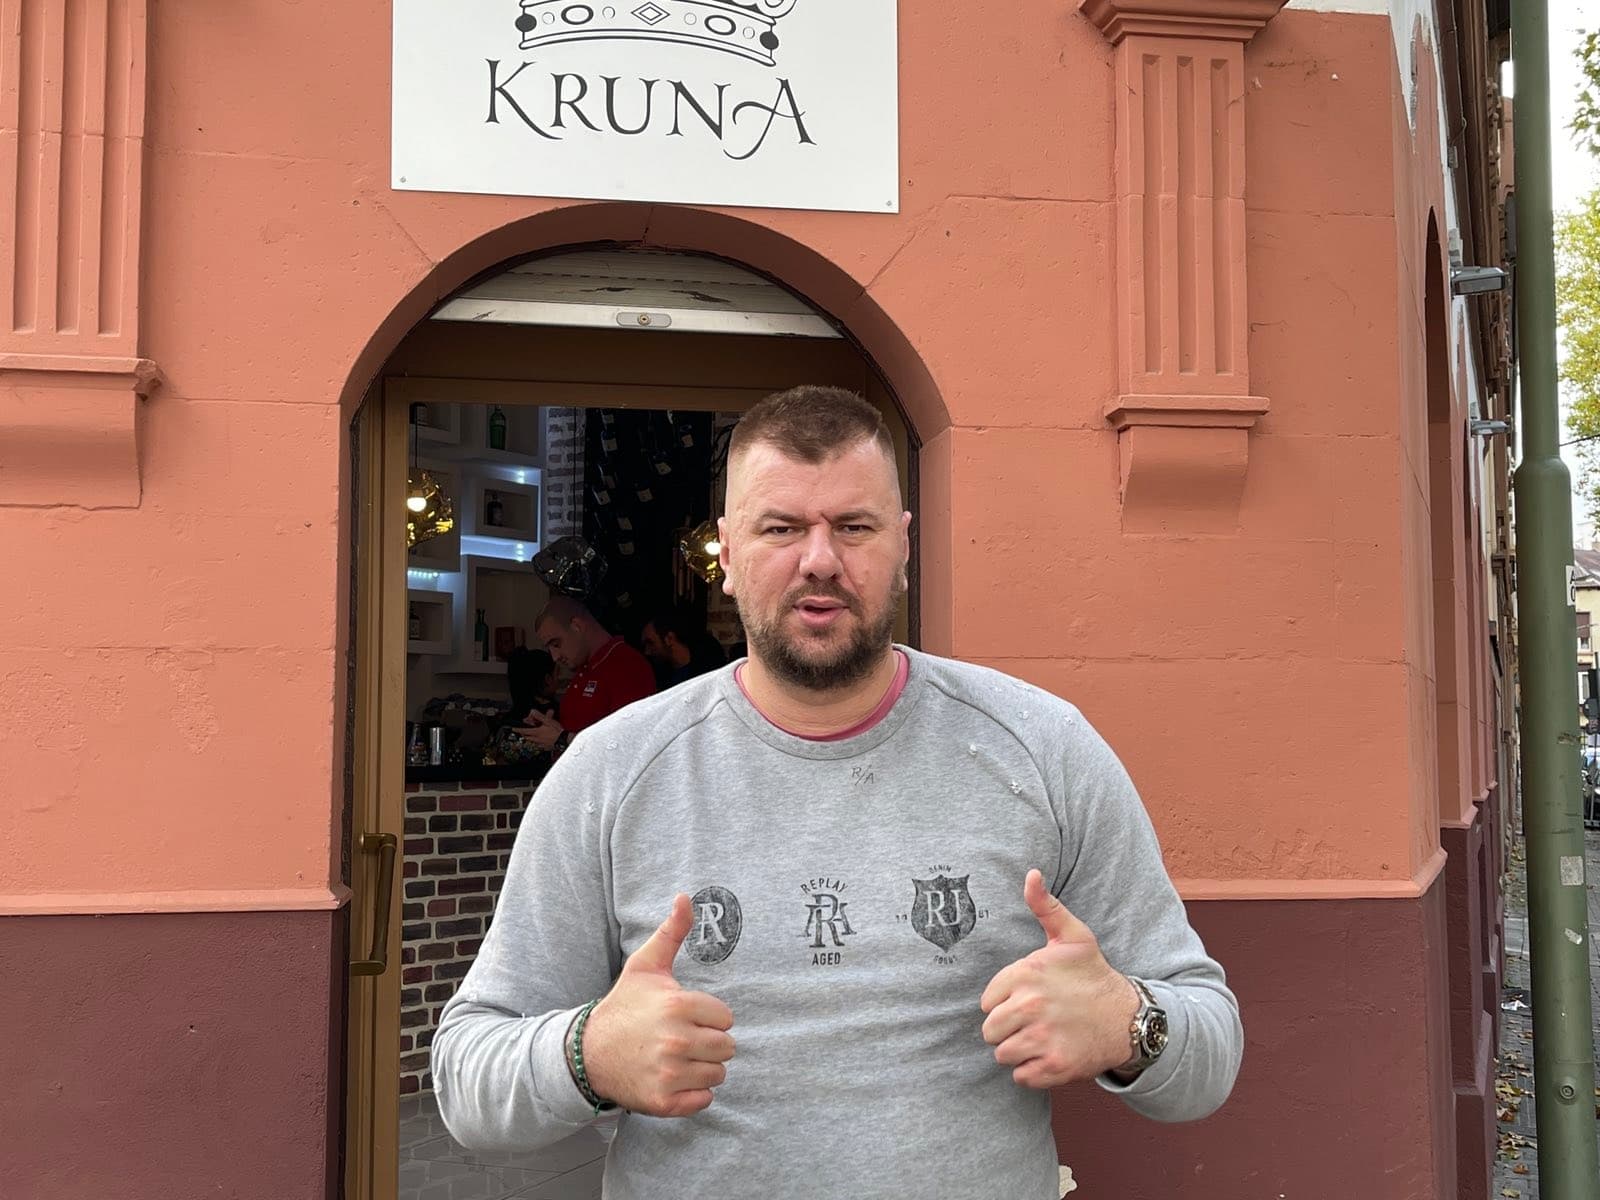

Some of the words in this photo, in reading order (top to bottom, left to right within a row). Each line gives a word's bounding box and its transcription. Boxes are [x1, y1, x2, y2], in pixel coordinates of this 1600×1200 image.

[485, 58, 817, 160] KRUNA
[800, 877, 848, 894] REPLAY
[922, 889, 961, 928] RJ
[811, 952, 841, 966] AGED
